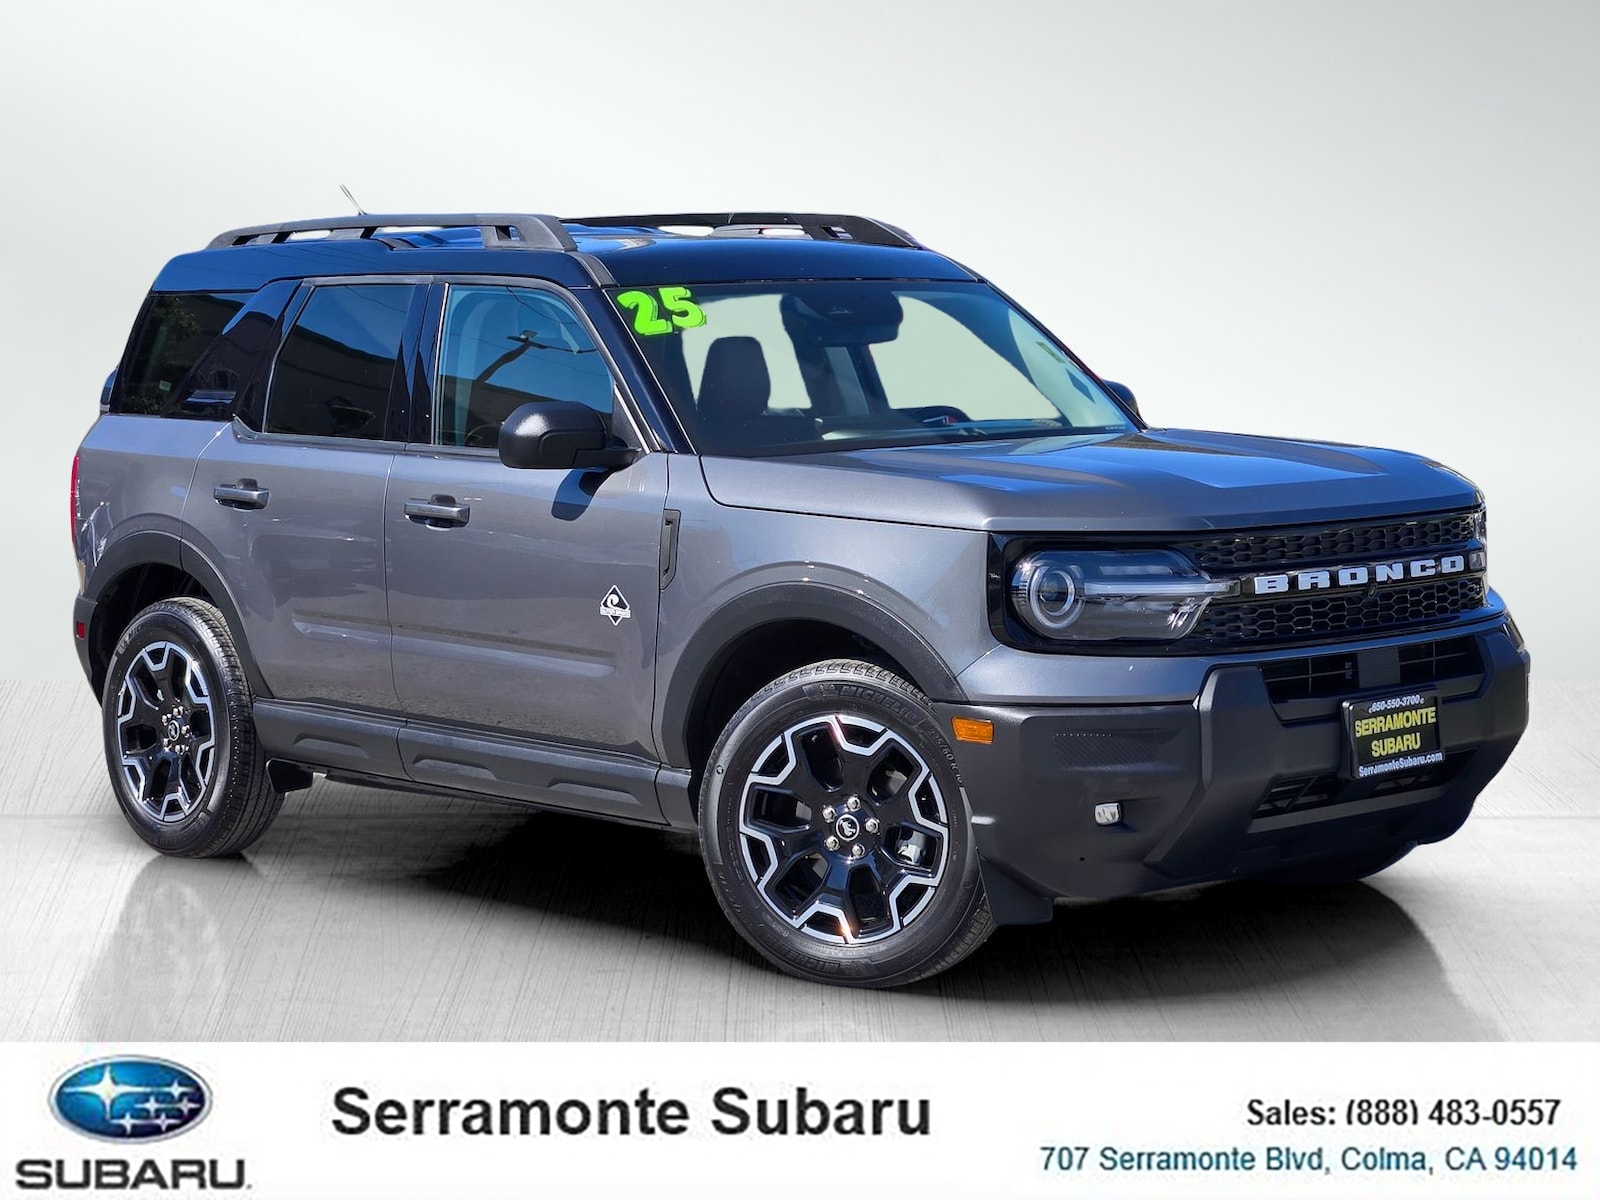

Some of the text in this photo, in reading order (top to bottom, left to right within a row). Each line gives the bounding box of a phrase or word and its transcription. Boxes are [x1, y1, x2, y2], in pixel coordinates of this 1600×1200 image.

[616, 286, 707, 336] 25
[1254, 555, 1465, 595] BRONCO
[840, 685, 919, 722] MICHELIN
[1371, 694, 1421, 712] 650-550-3700
[1355, 706, 1437, 738] SERRAMONTE
[1371, 732, 1421, 758] SUBARU
[1359, 752, 1443, 777] SerramonteSubaru.com
